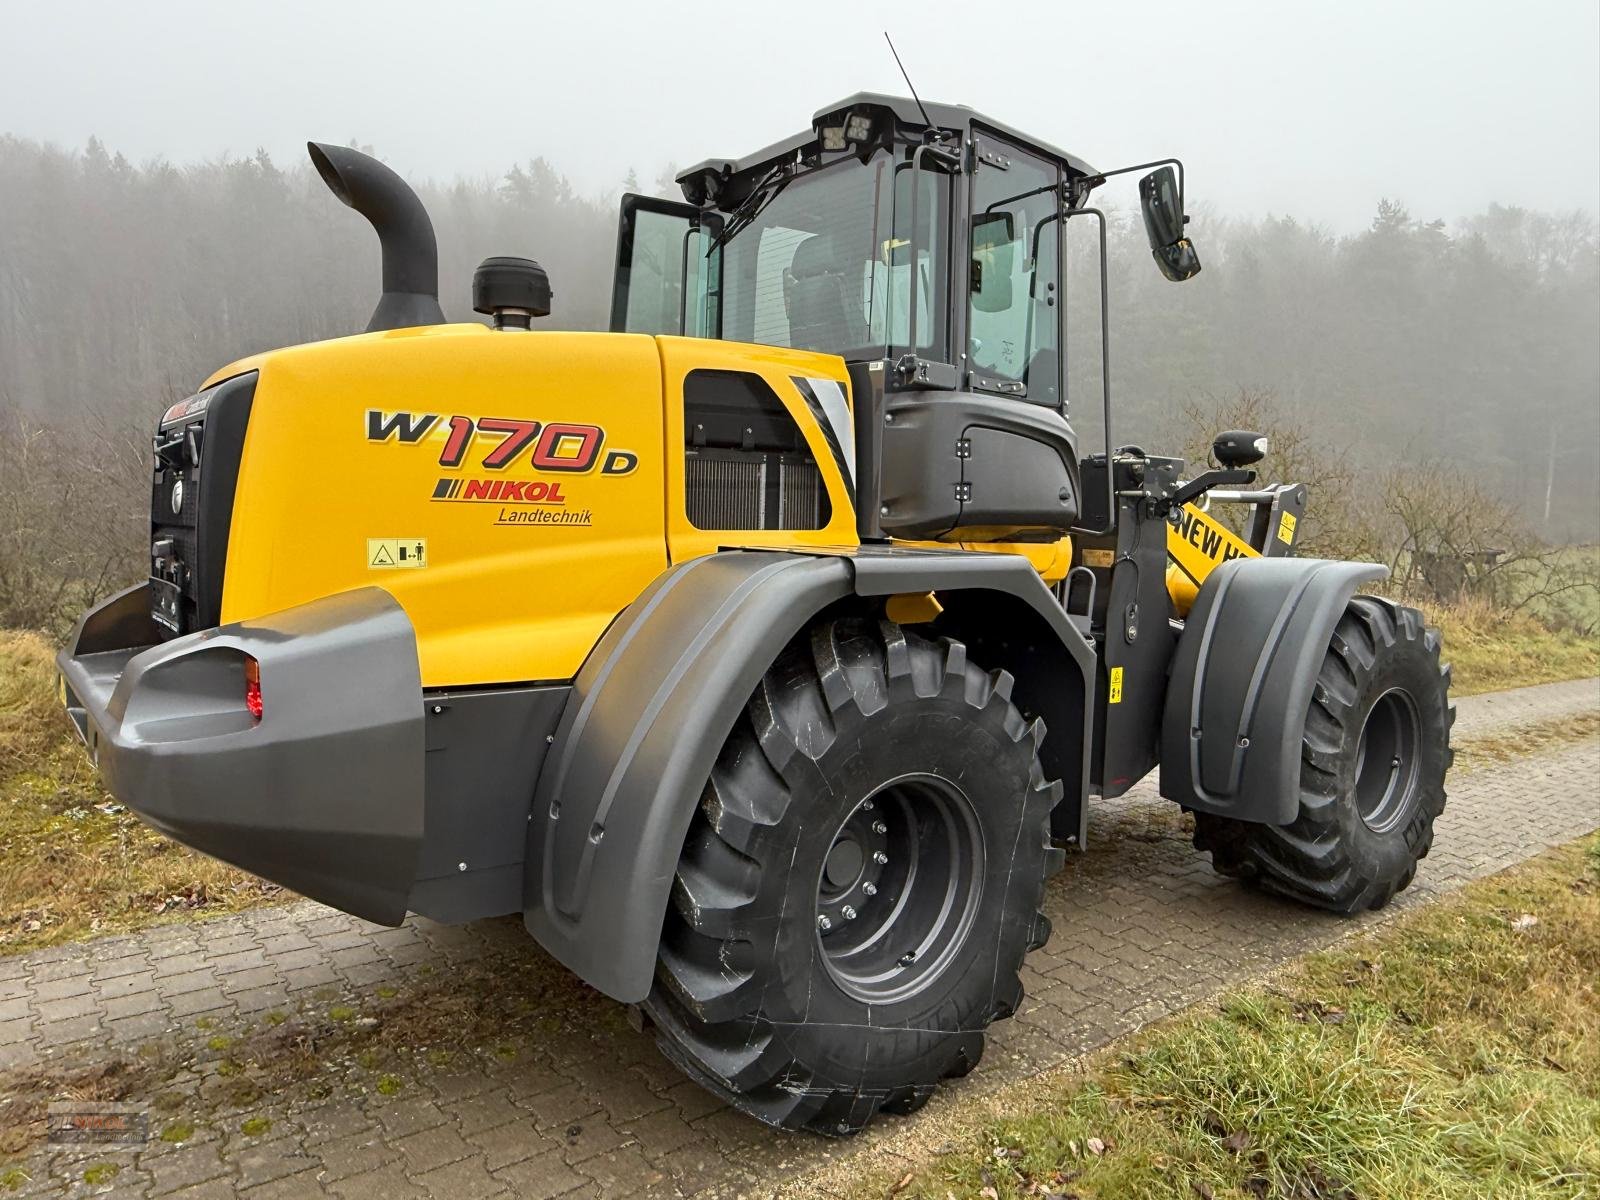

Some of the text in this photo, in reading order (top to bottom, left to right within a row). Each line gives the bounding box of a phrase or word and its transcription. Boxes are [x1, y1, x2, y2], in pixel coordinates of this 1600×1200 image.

[463, 479, 566, 502] NIKOL
[498, 508, 592, 524] Landtechnik
[1173, 511, 1223, 561] NEW
